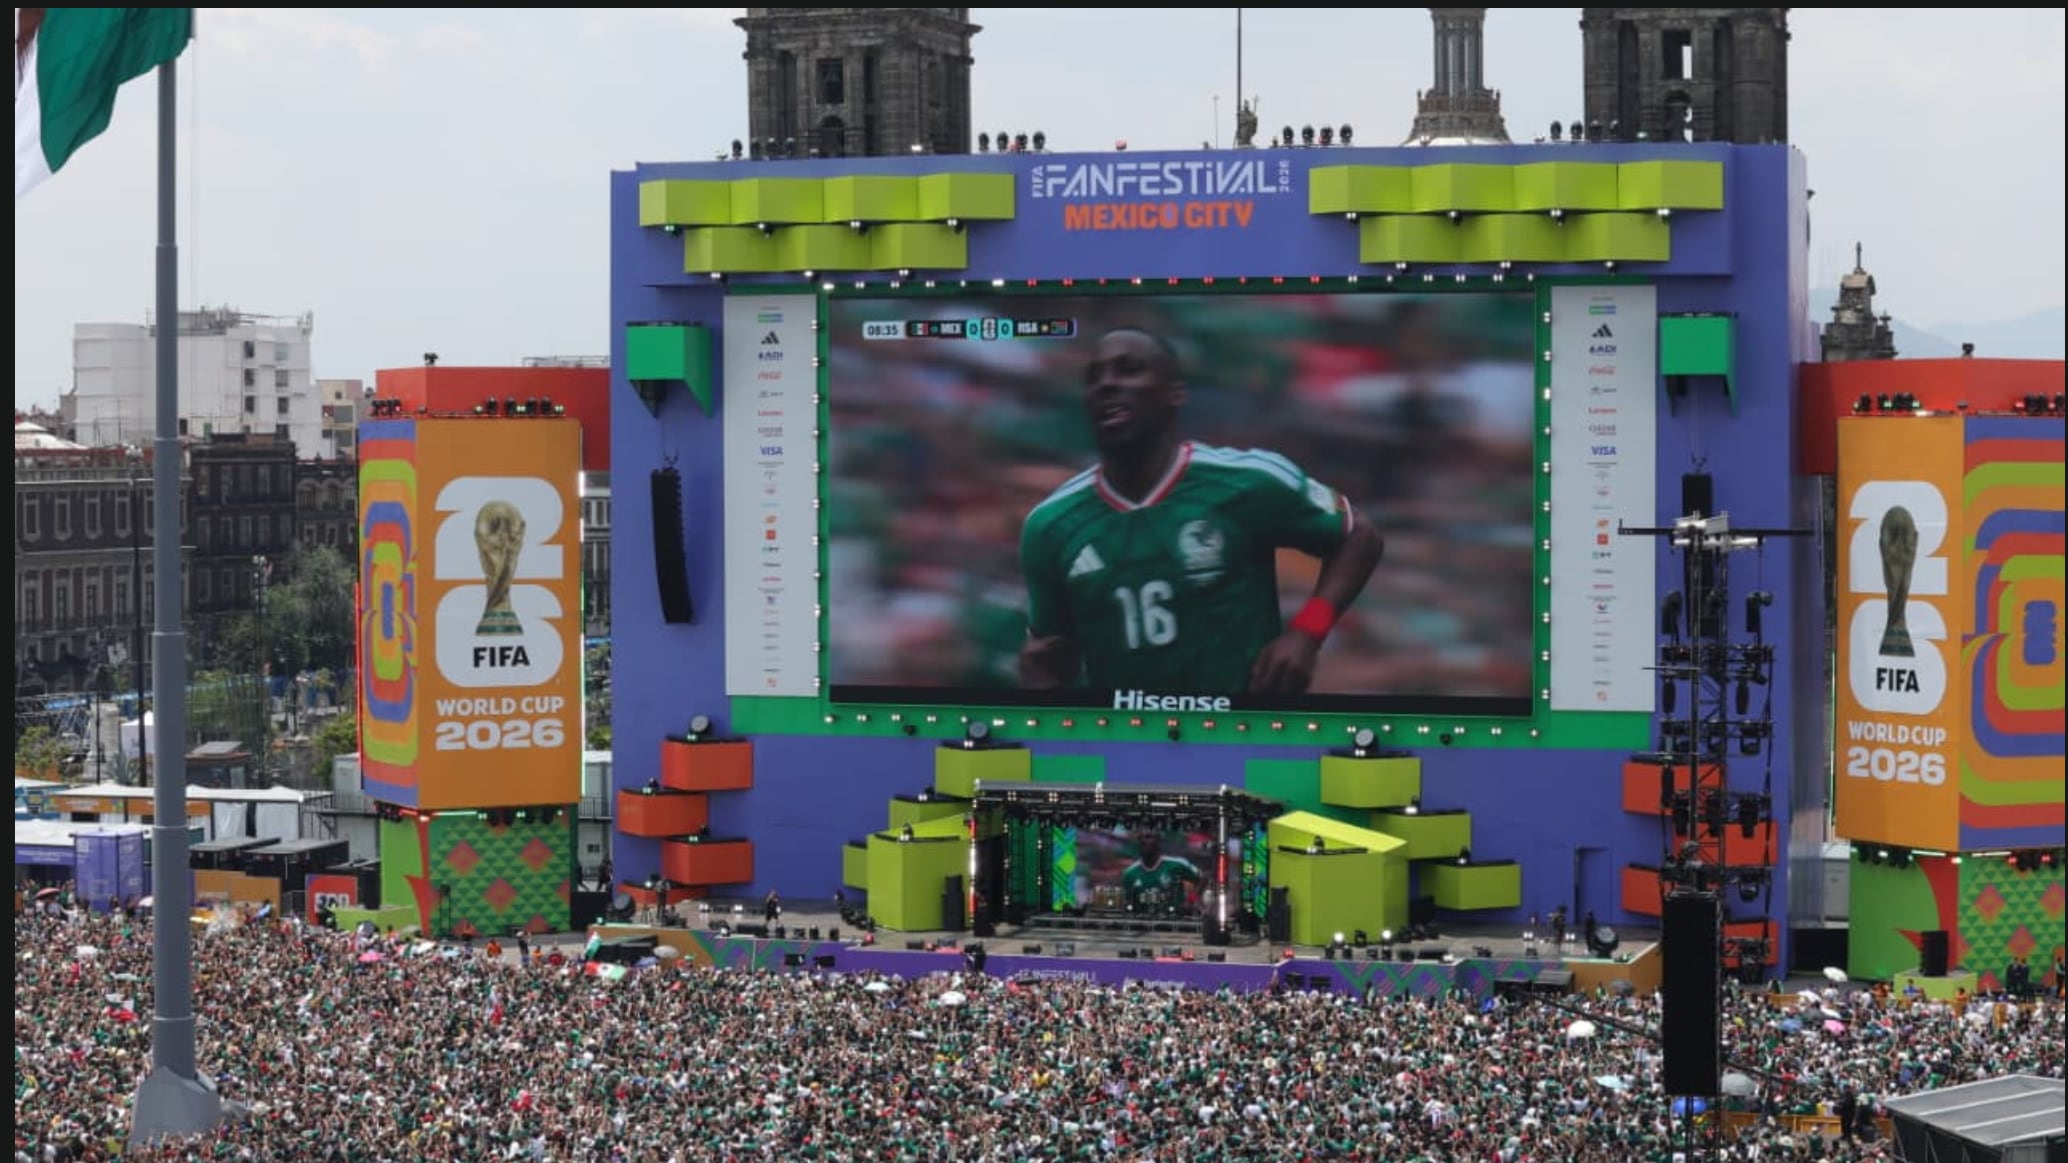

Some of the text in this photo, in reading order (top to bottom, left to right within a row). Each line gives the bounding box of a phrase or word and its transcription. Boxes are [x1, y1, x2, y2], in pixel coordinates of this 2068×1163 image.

[1032, 165, 1044, 198] FIFA
[1278, 160, 1290, 193] 2026
[1065, 202, 1178, 230] MEXICO
[969, 323, 978, 335] 0
[1001, 323, 1010, 335] 0
[760, 446, 784, 456] VISA
[1592, 446, 1616, 456] VISA
[1114, 580, 1177, 649] 16
[473, 646, 530, 668] FIFA
[1876, 667, 1920, 693] FIFA
[436, 696, 565, 716] WORLD CUP
[1114, 690, 1231, 711] Hisense
[435, 719, 565, 750] 2026
[1848, 720, 1946, 746] WORLD CUP
[1847, 746, 1946, 786] 2026
